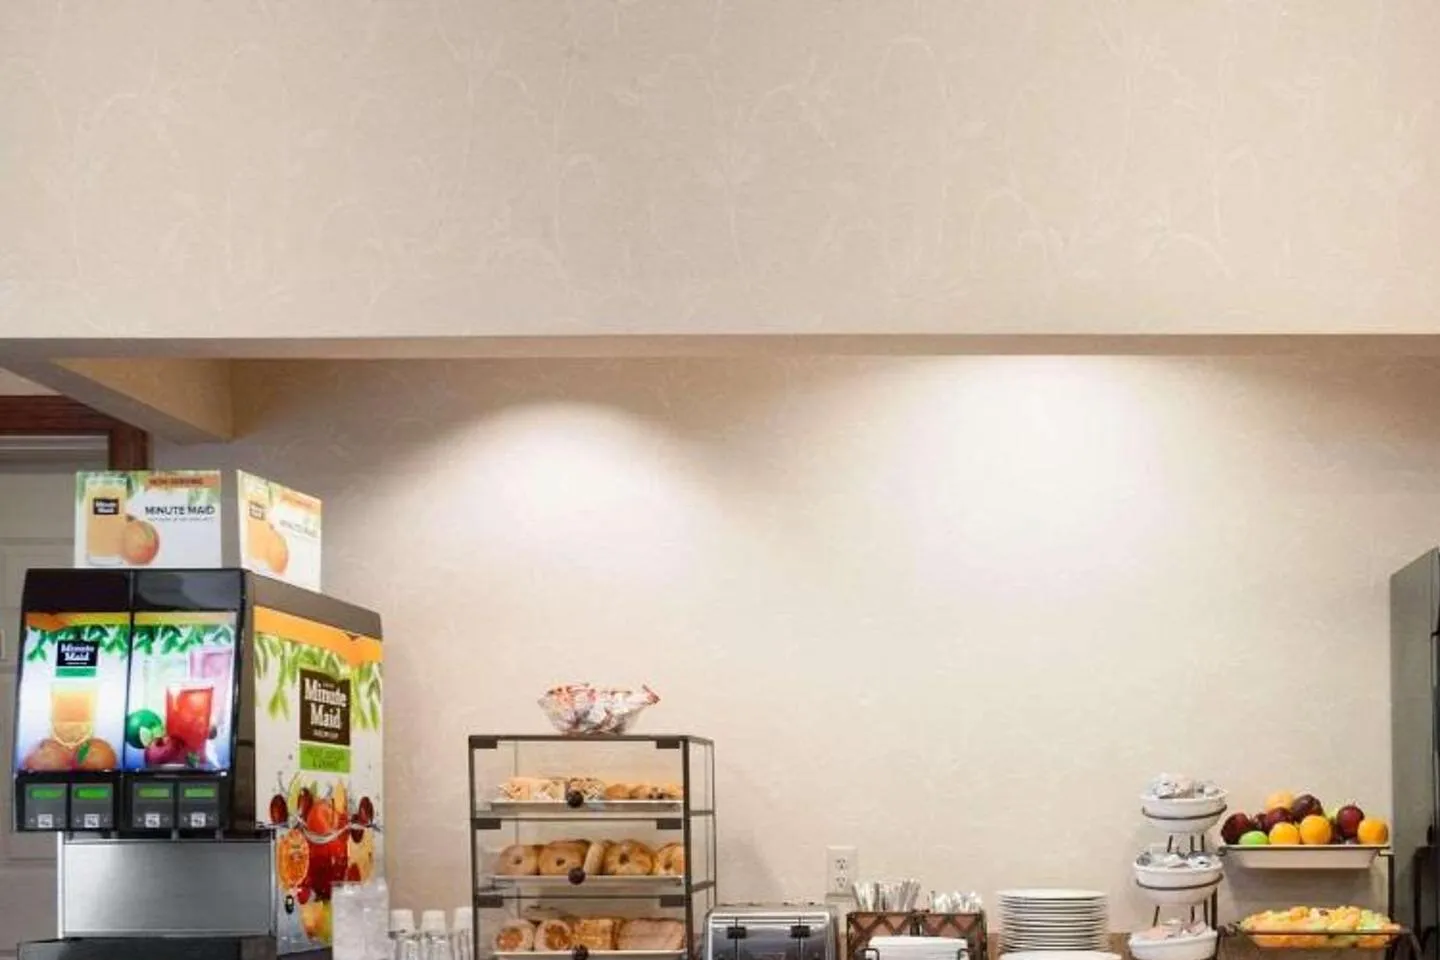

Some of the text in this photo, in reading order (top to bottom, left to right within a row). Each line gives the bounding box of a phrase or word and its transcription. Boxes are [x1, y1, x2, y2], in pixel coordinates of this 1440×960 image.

[145, 504, 215, 515] MINUTE MAID
[64, 651, 89, 661] Maid
[304, 677, 347, 707] Minute
[310, 702, 341, 729] Maid
